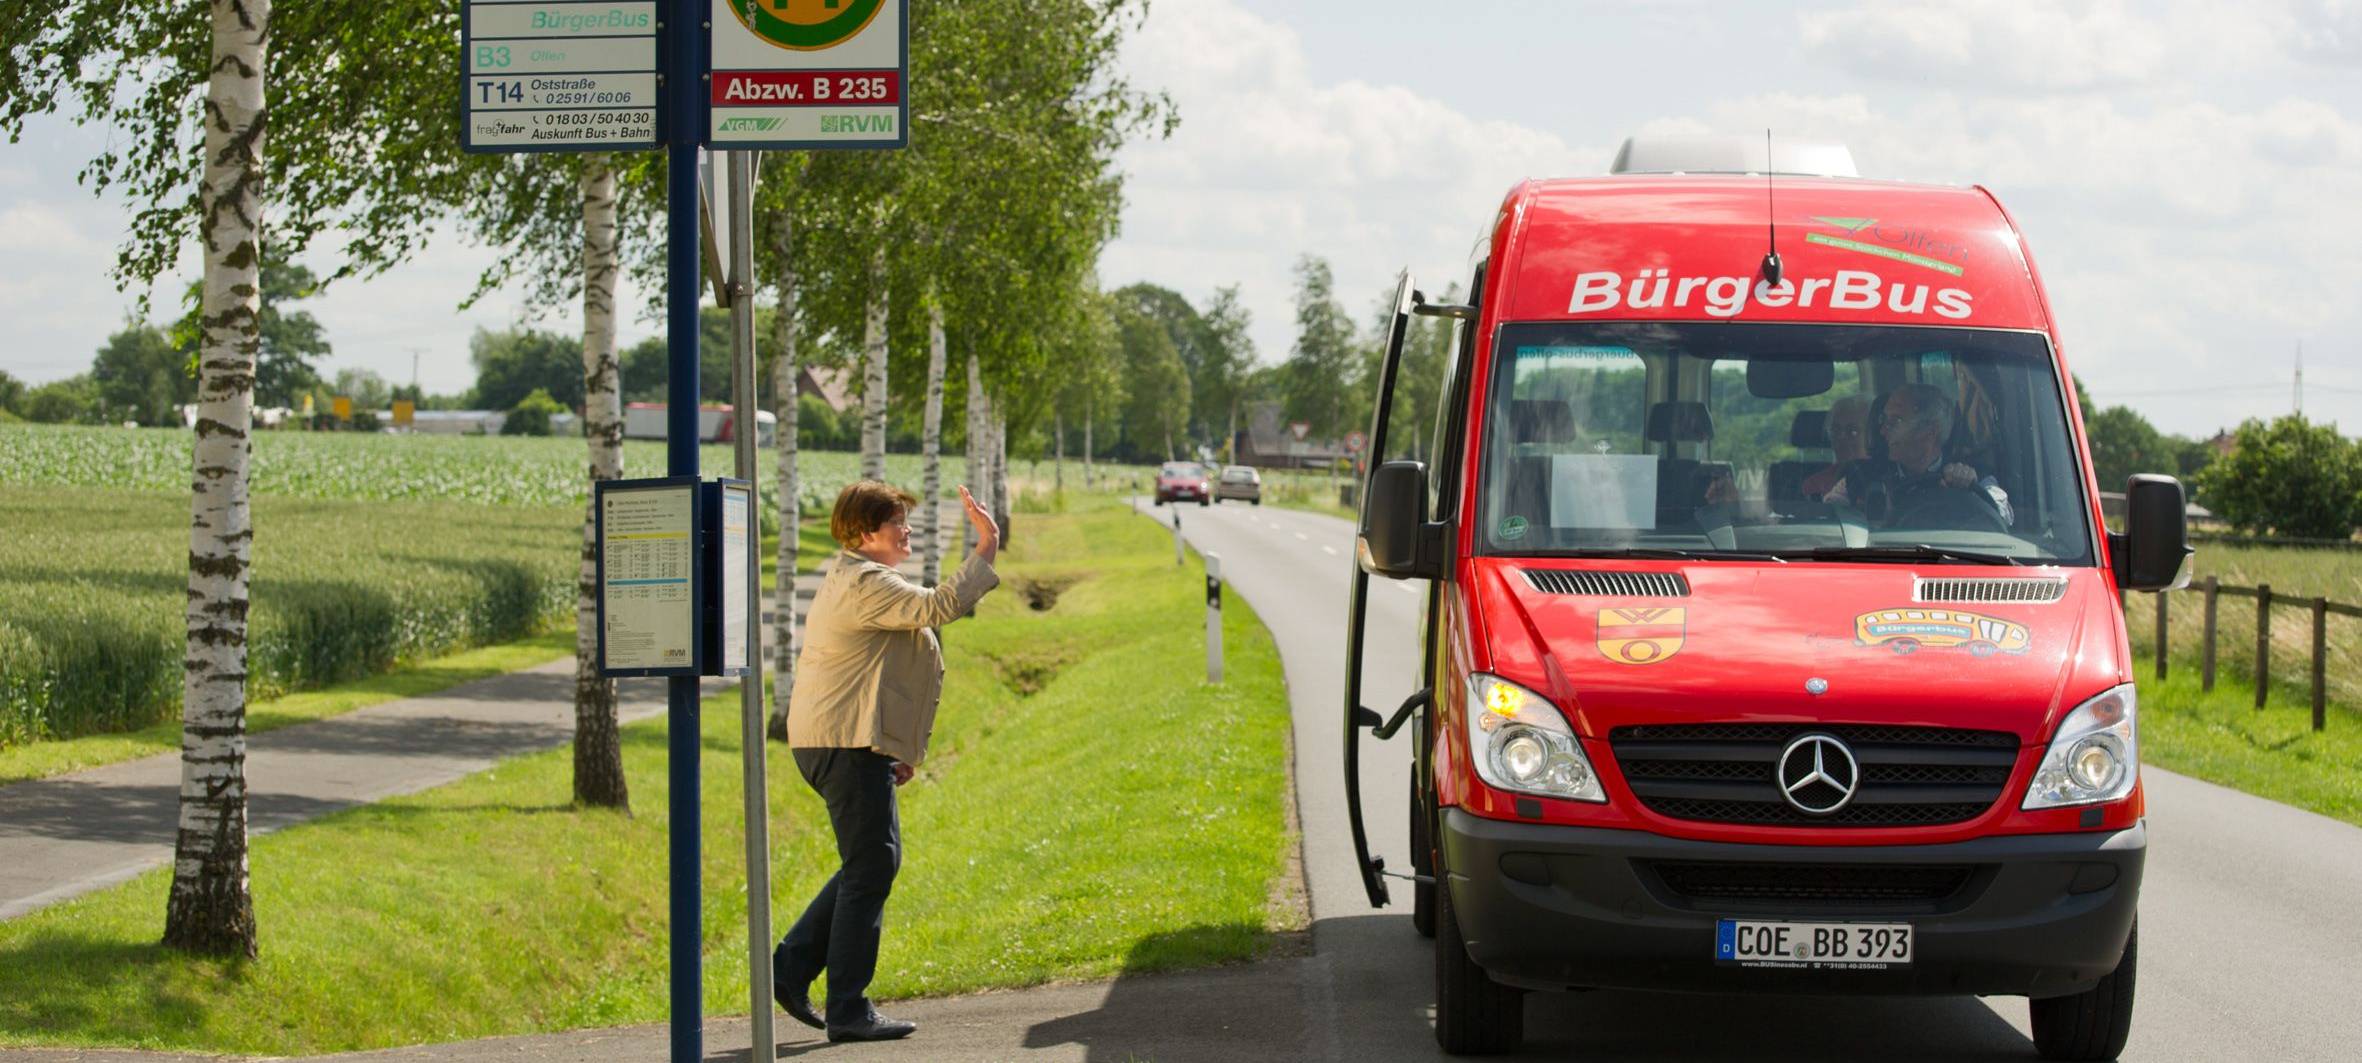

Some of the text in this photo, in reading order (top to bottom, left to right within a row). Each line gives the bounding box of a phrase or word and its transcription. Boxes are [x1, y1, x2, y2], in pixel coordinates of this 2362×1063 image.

[530, 9, 649, 32] BürgerBus
[476, 46, 511, 68] B3
[477, 81, 525, 104] T14
[531, 78, 596, 91] Oststraße
[724, 77, 887, 100] Abzw. B 235
[531, 127, 583, 140] Auskunft
[585, 128, 608, 139] Bus
[620, 127, 650, 138] Bahn
[727, 120, 758, 131] VGM
[840, 115, 893, 132] RVM
[1567, 269, 1974, 319] BürgerBus
[1723, 926, 1909, 958] D COE BB 393
